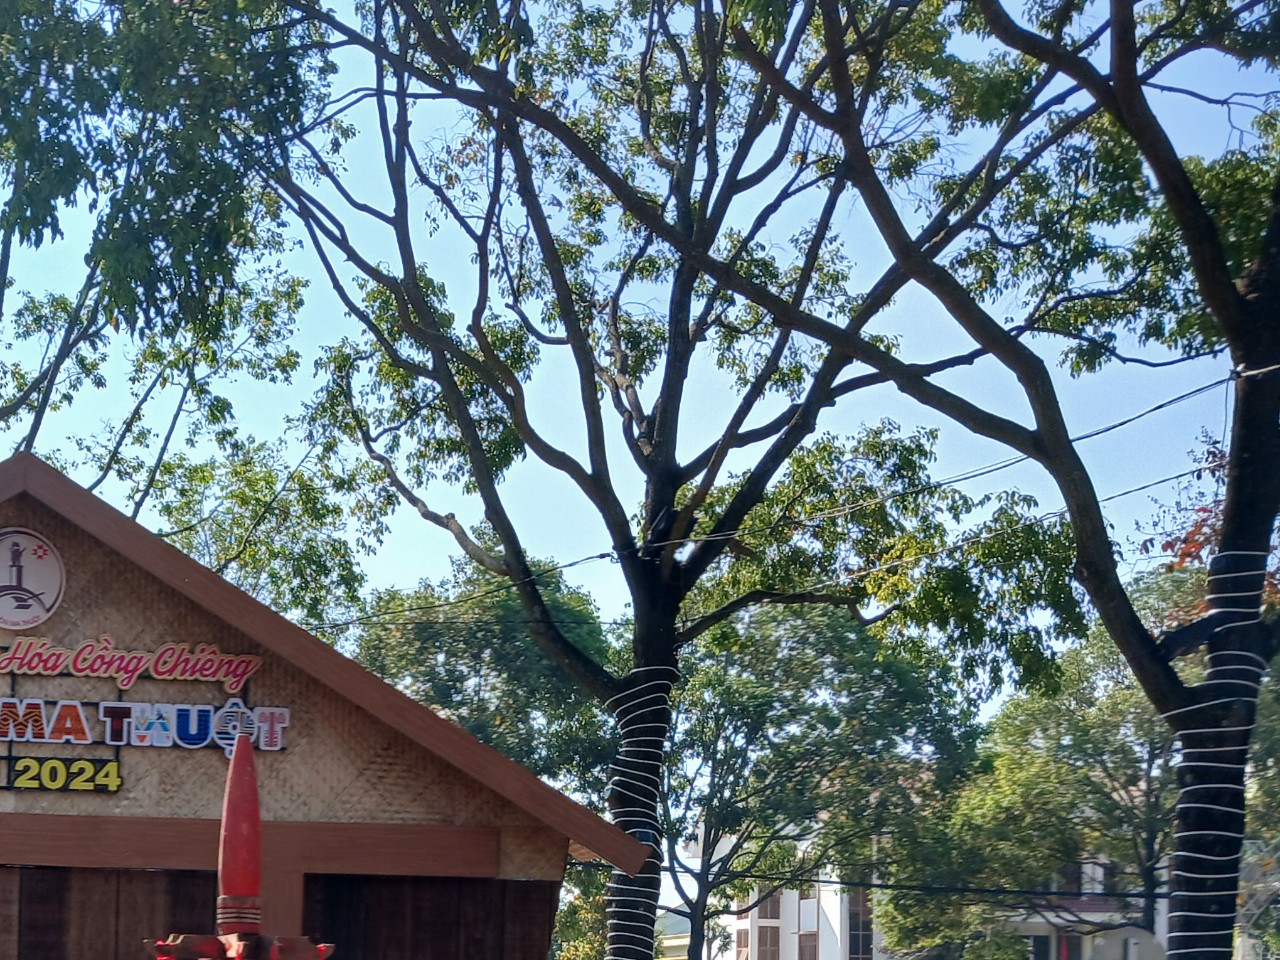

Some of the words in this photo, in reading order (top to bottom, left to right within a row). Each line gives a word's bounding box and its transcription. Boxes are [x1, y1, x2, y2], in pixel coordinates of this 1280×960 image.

[72, 636, 152, 688] Cồng
[152, 645, 261, 692] Chiêng
[99, 698, 290, 759] THUỘT
[13, 757, 122, 791] 2024
